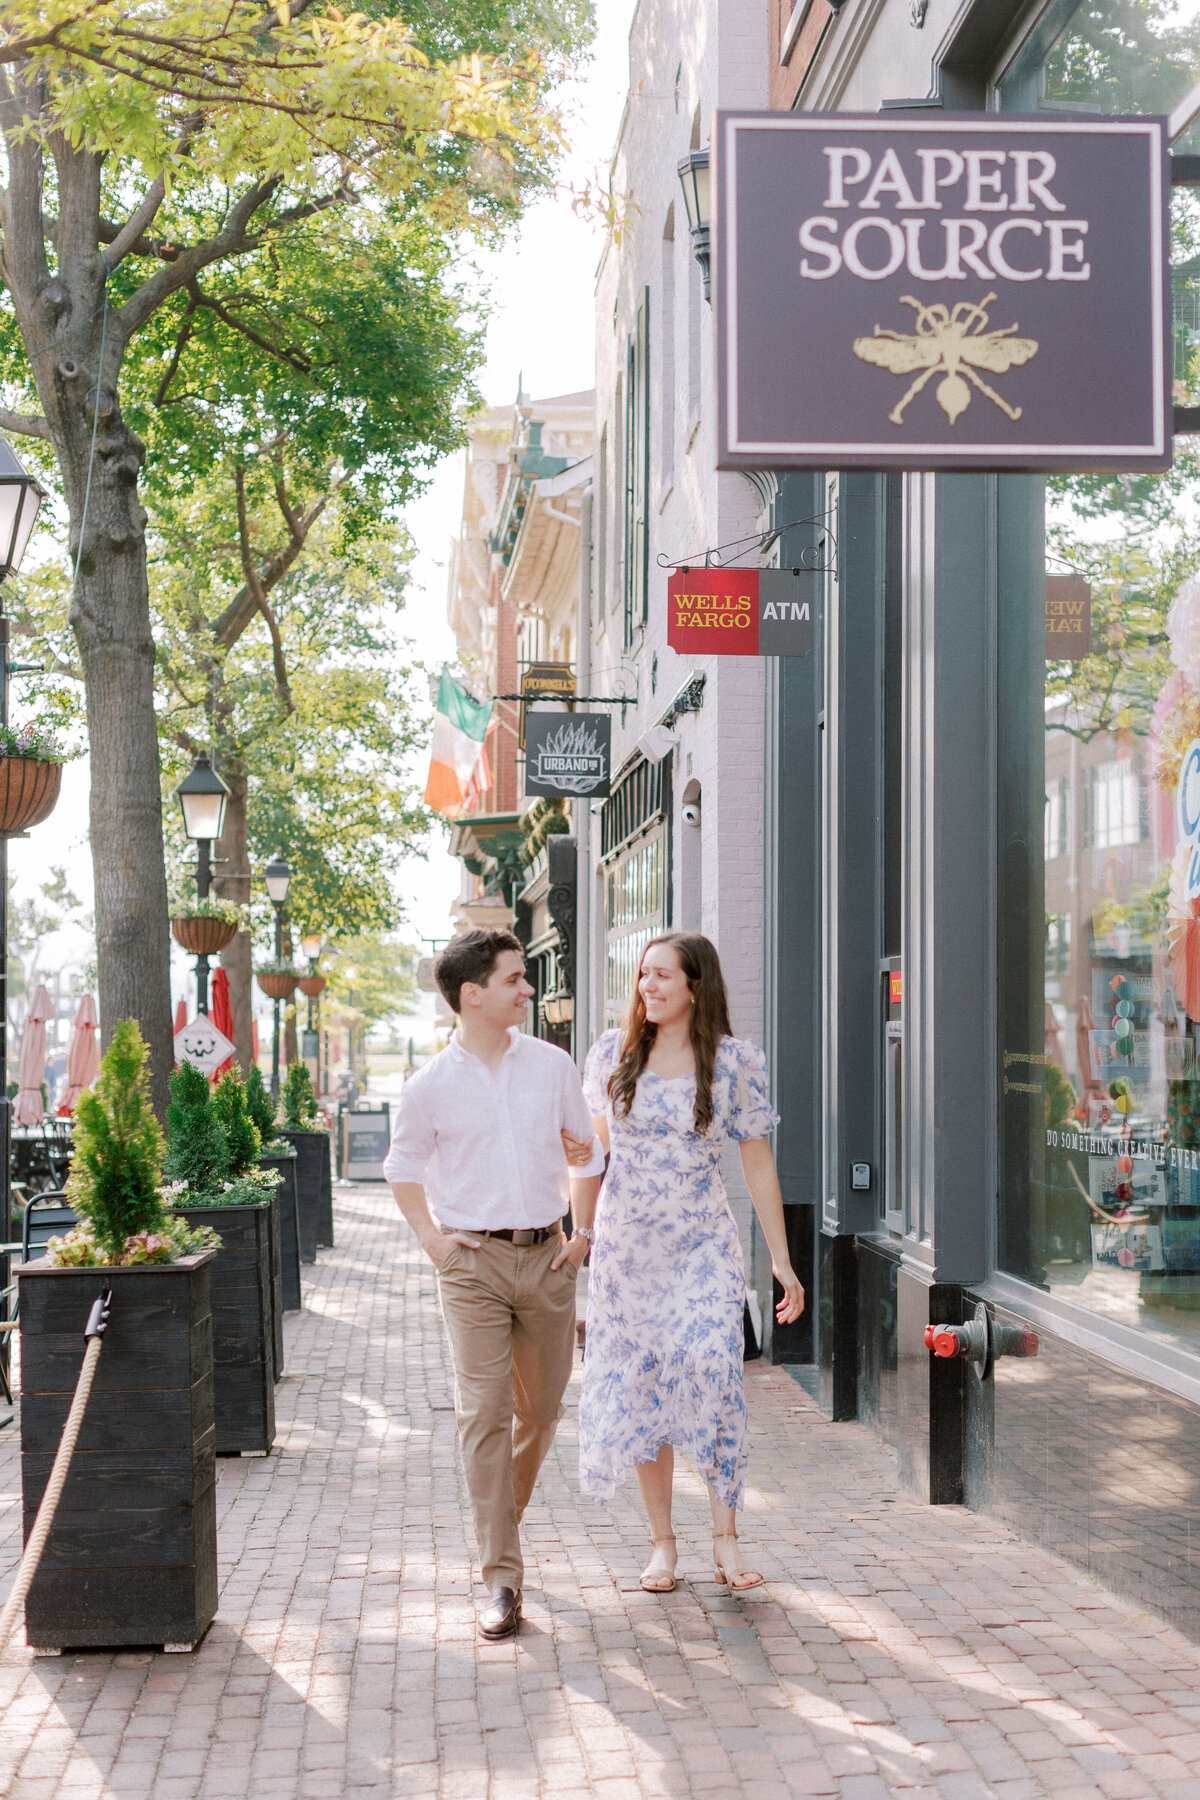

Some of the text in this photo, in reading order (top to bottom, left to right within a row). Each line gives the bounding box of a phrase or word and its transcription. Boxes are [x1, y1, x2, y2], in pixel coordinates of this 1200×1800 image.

[823, 147, 1066, 212] PAPER
[799, 216, 1090, 282] SOURCE
[673, 594, 751, 610] WELLS
[762, 602, 810, 621] ATM
[675, 612, 751, 628] FARGO
[544, 757, 588, 771] URBANO
[1047, 1130, 1200, 1170] DO SOMETHING CREATIVE EVER
